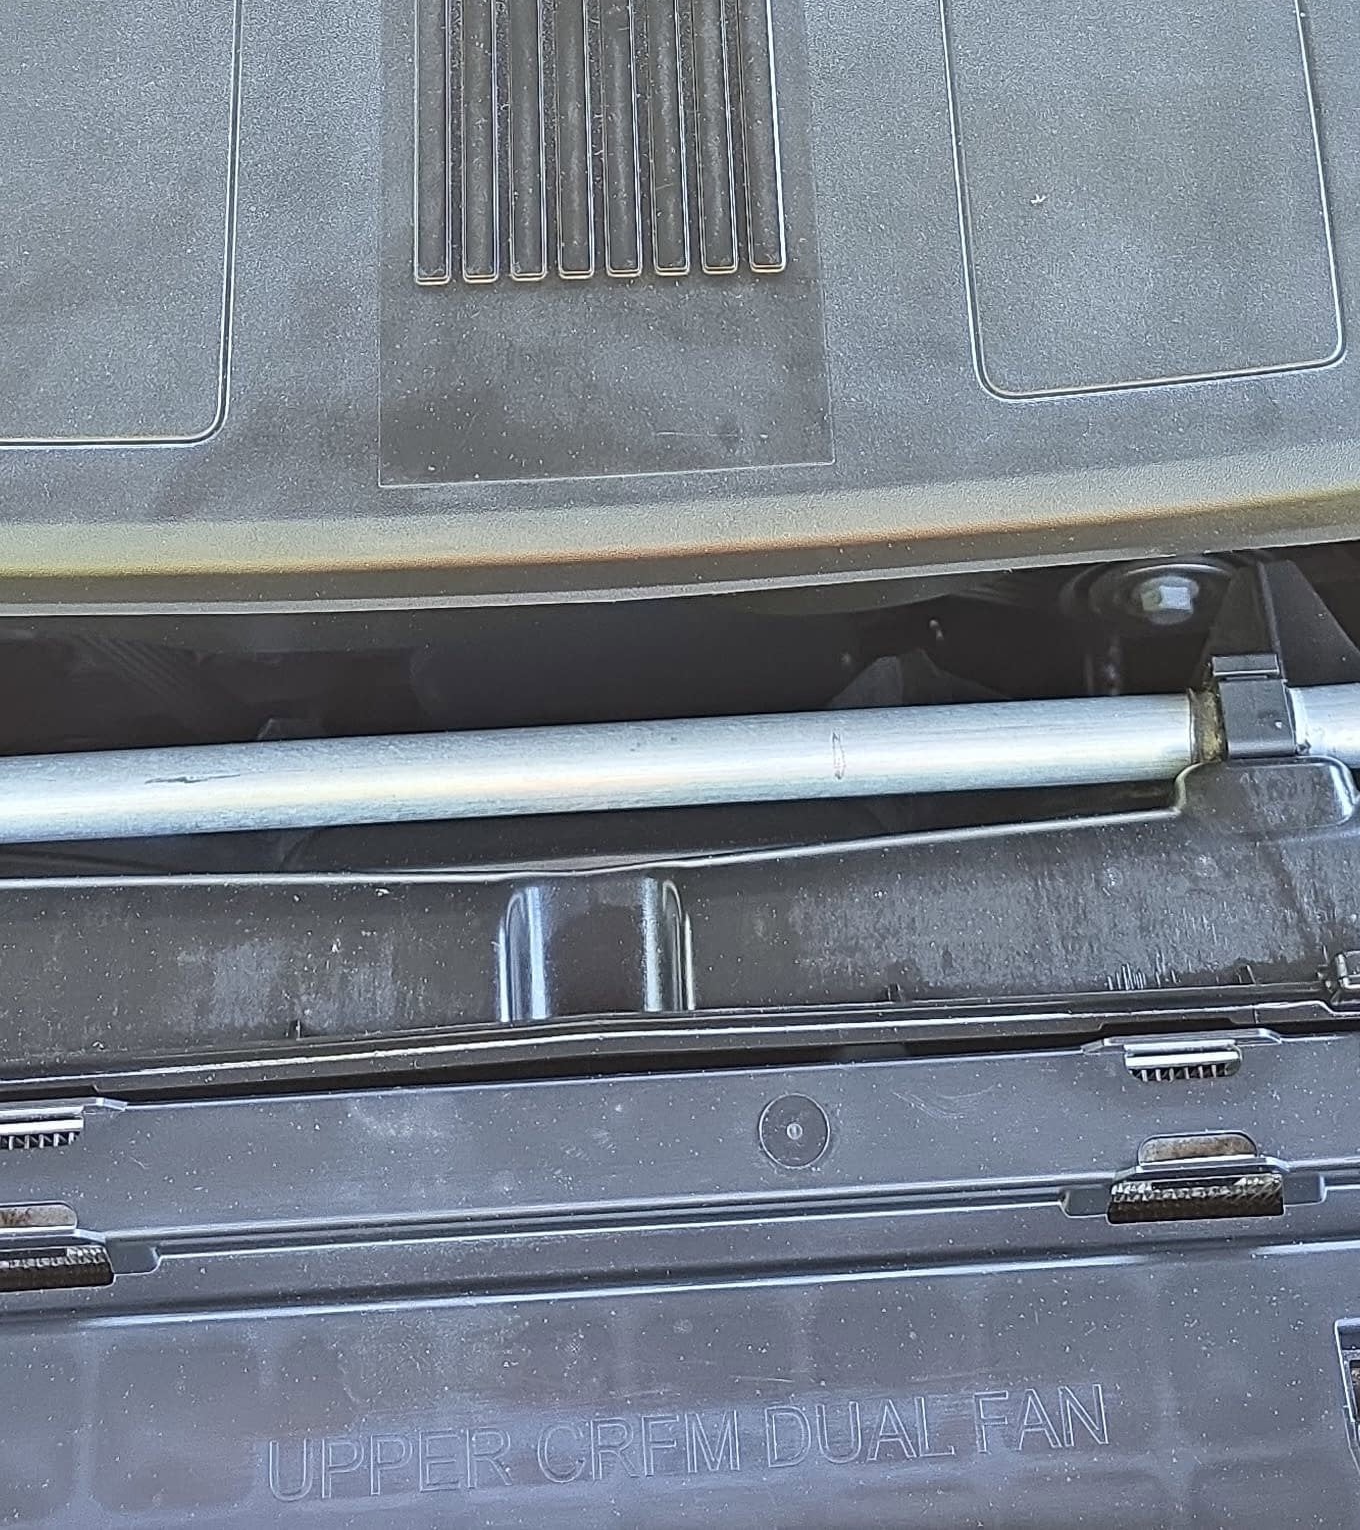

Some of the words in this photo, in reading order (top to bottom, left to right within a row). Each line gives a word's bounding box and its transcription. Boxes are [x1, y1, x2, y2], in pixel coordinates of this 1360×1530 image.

[264, 1424, 513, 1503] UPPER
[535, 1408, 742, 1485] CRFM
[762, 1394, 955, 1469] DUAL
[971, 1382, 1111, 1454] FAN
